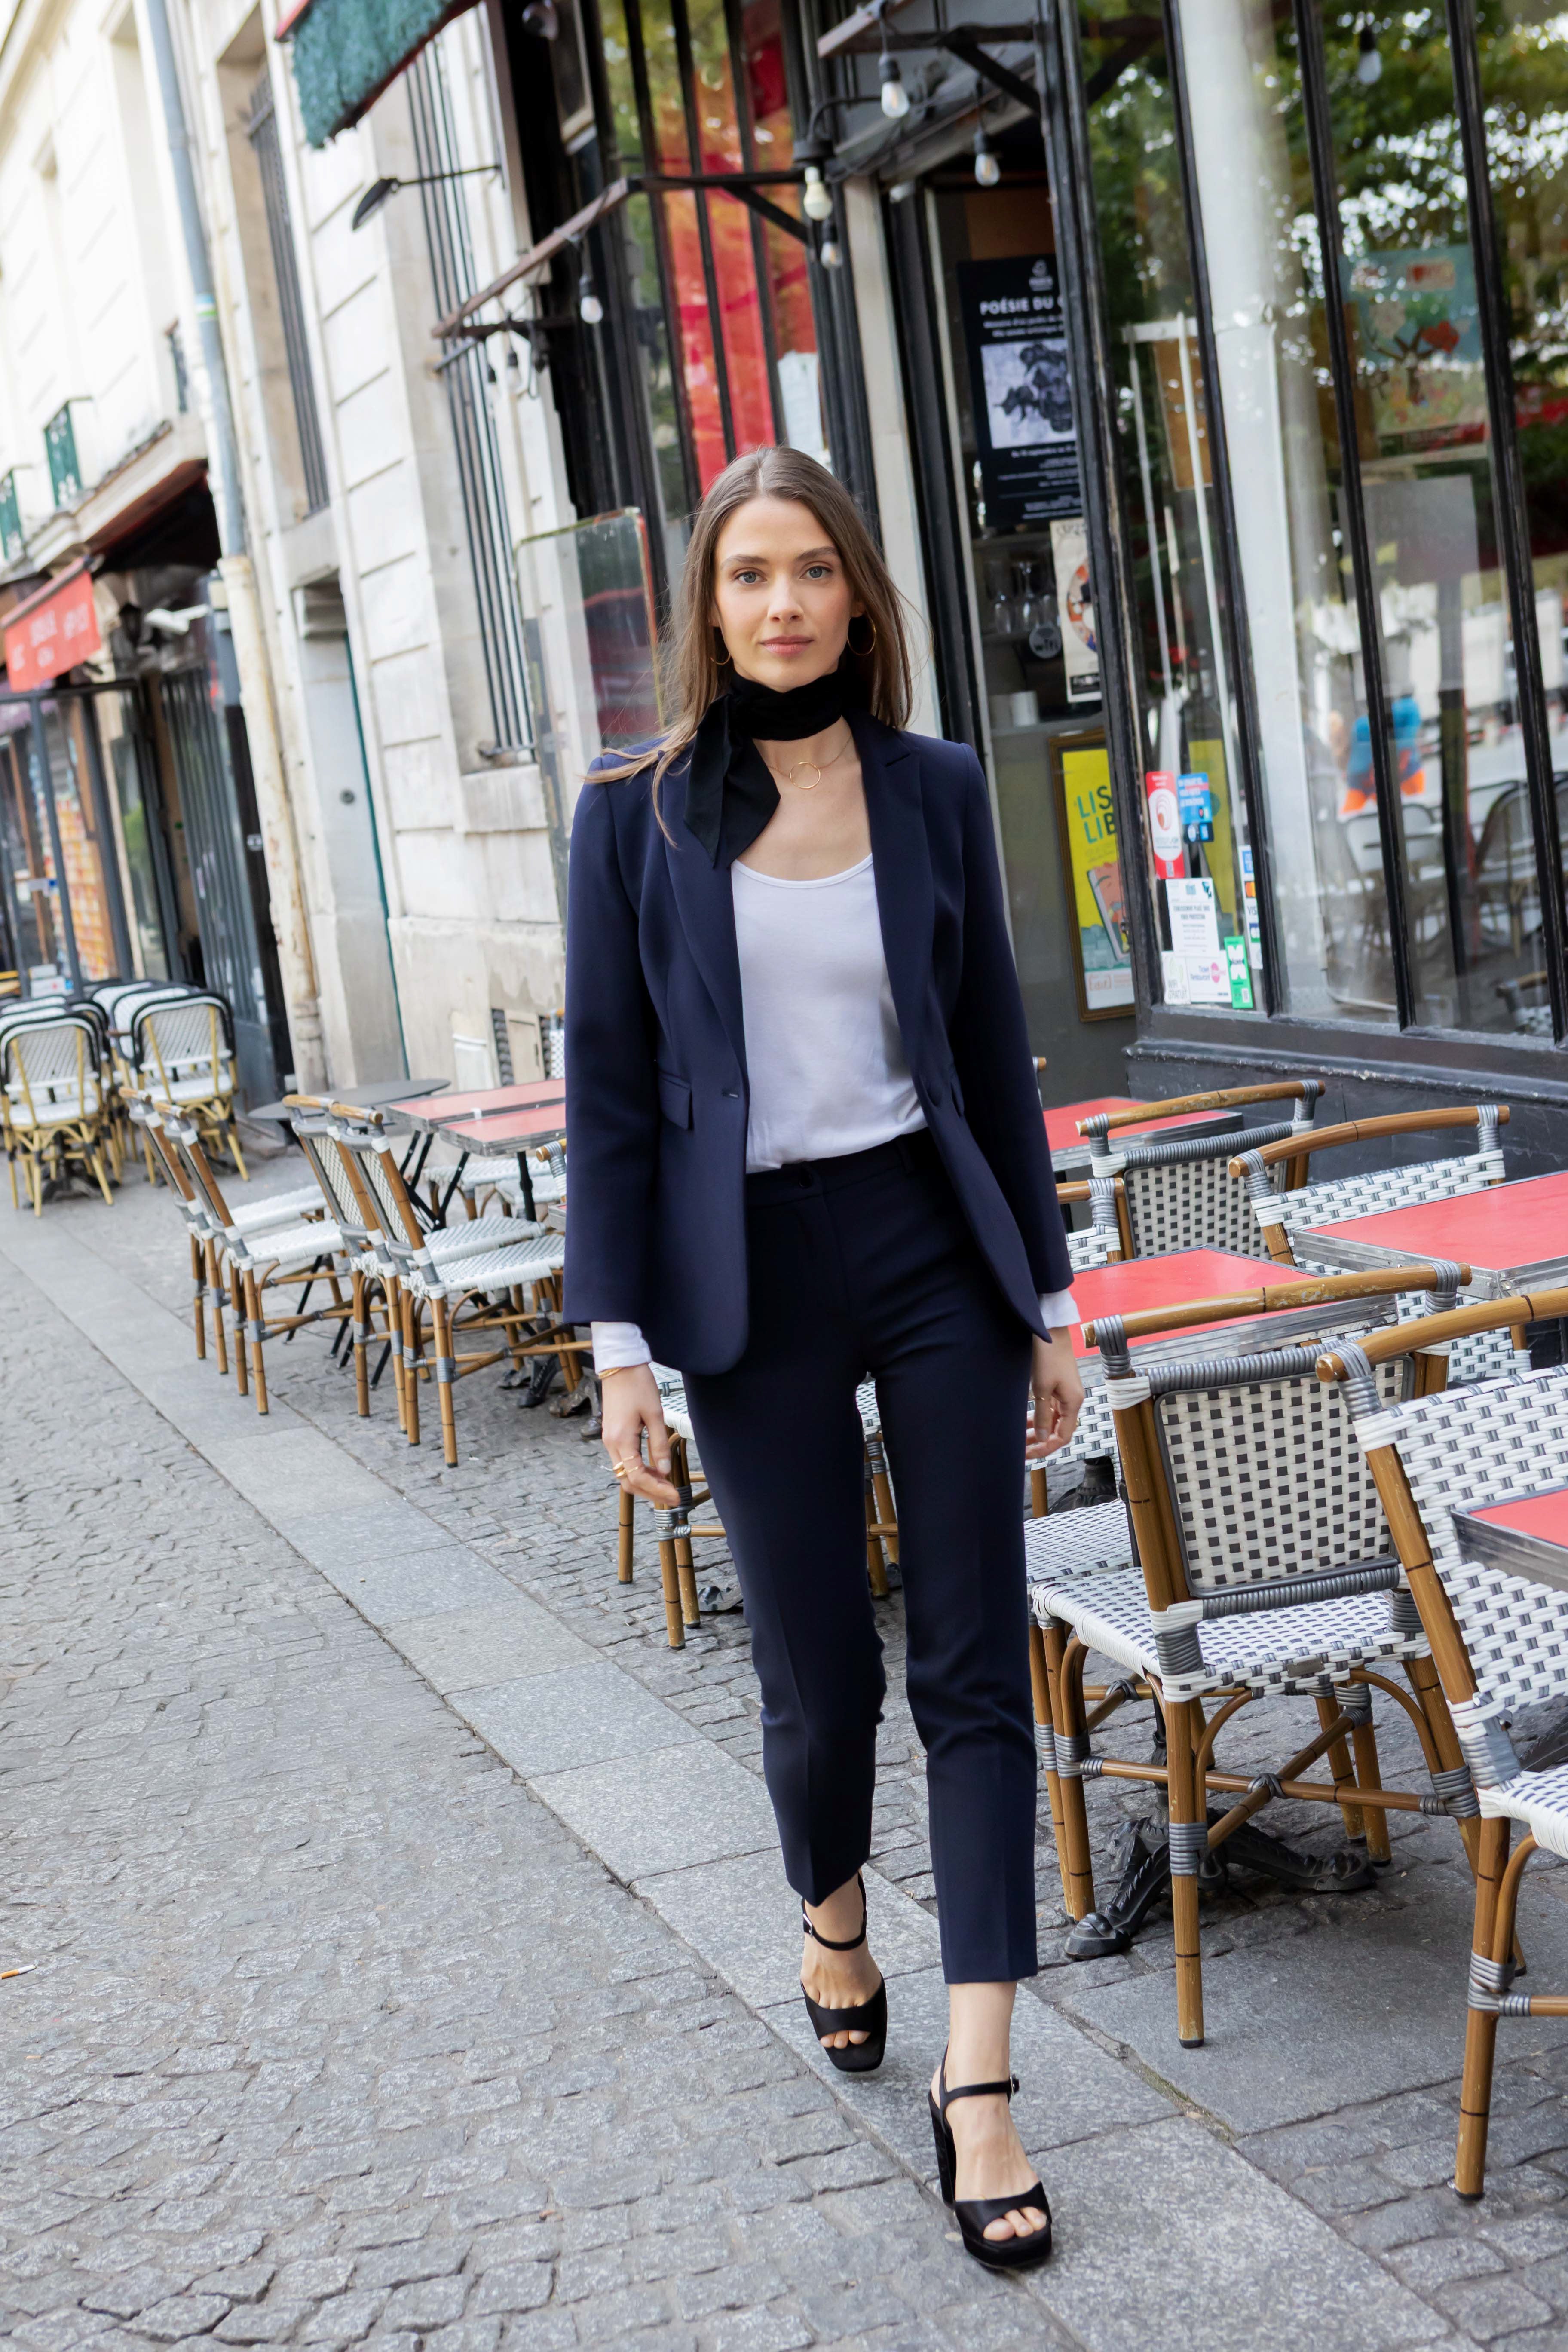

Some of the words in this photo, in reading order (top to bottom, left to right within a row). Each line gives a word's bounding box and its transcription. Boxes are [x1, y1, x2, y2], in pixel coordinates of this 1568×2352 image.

[980, 297, 1029, 316] POÉSIE
[1032, 296, 1053, 311] DU
[1077, 785, 1112, 819] LIS
[1084, 812, 1116, 844] LIB
